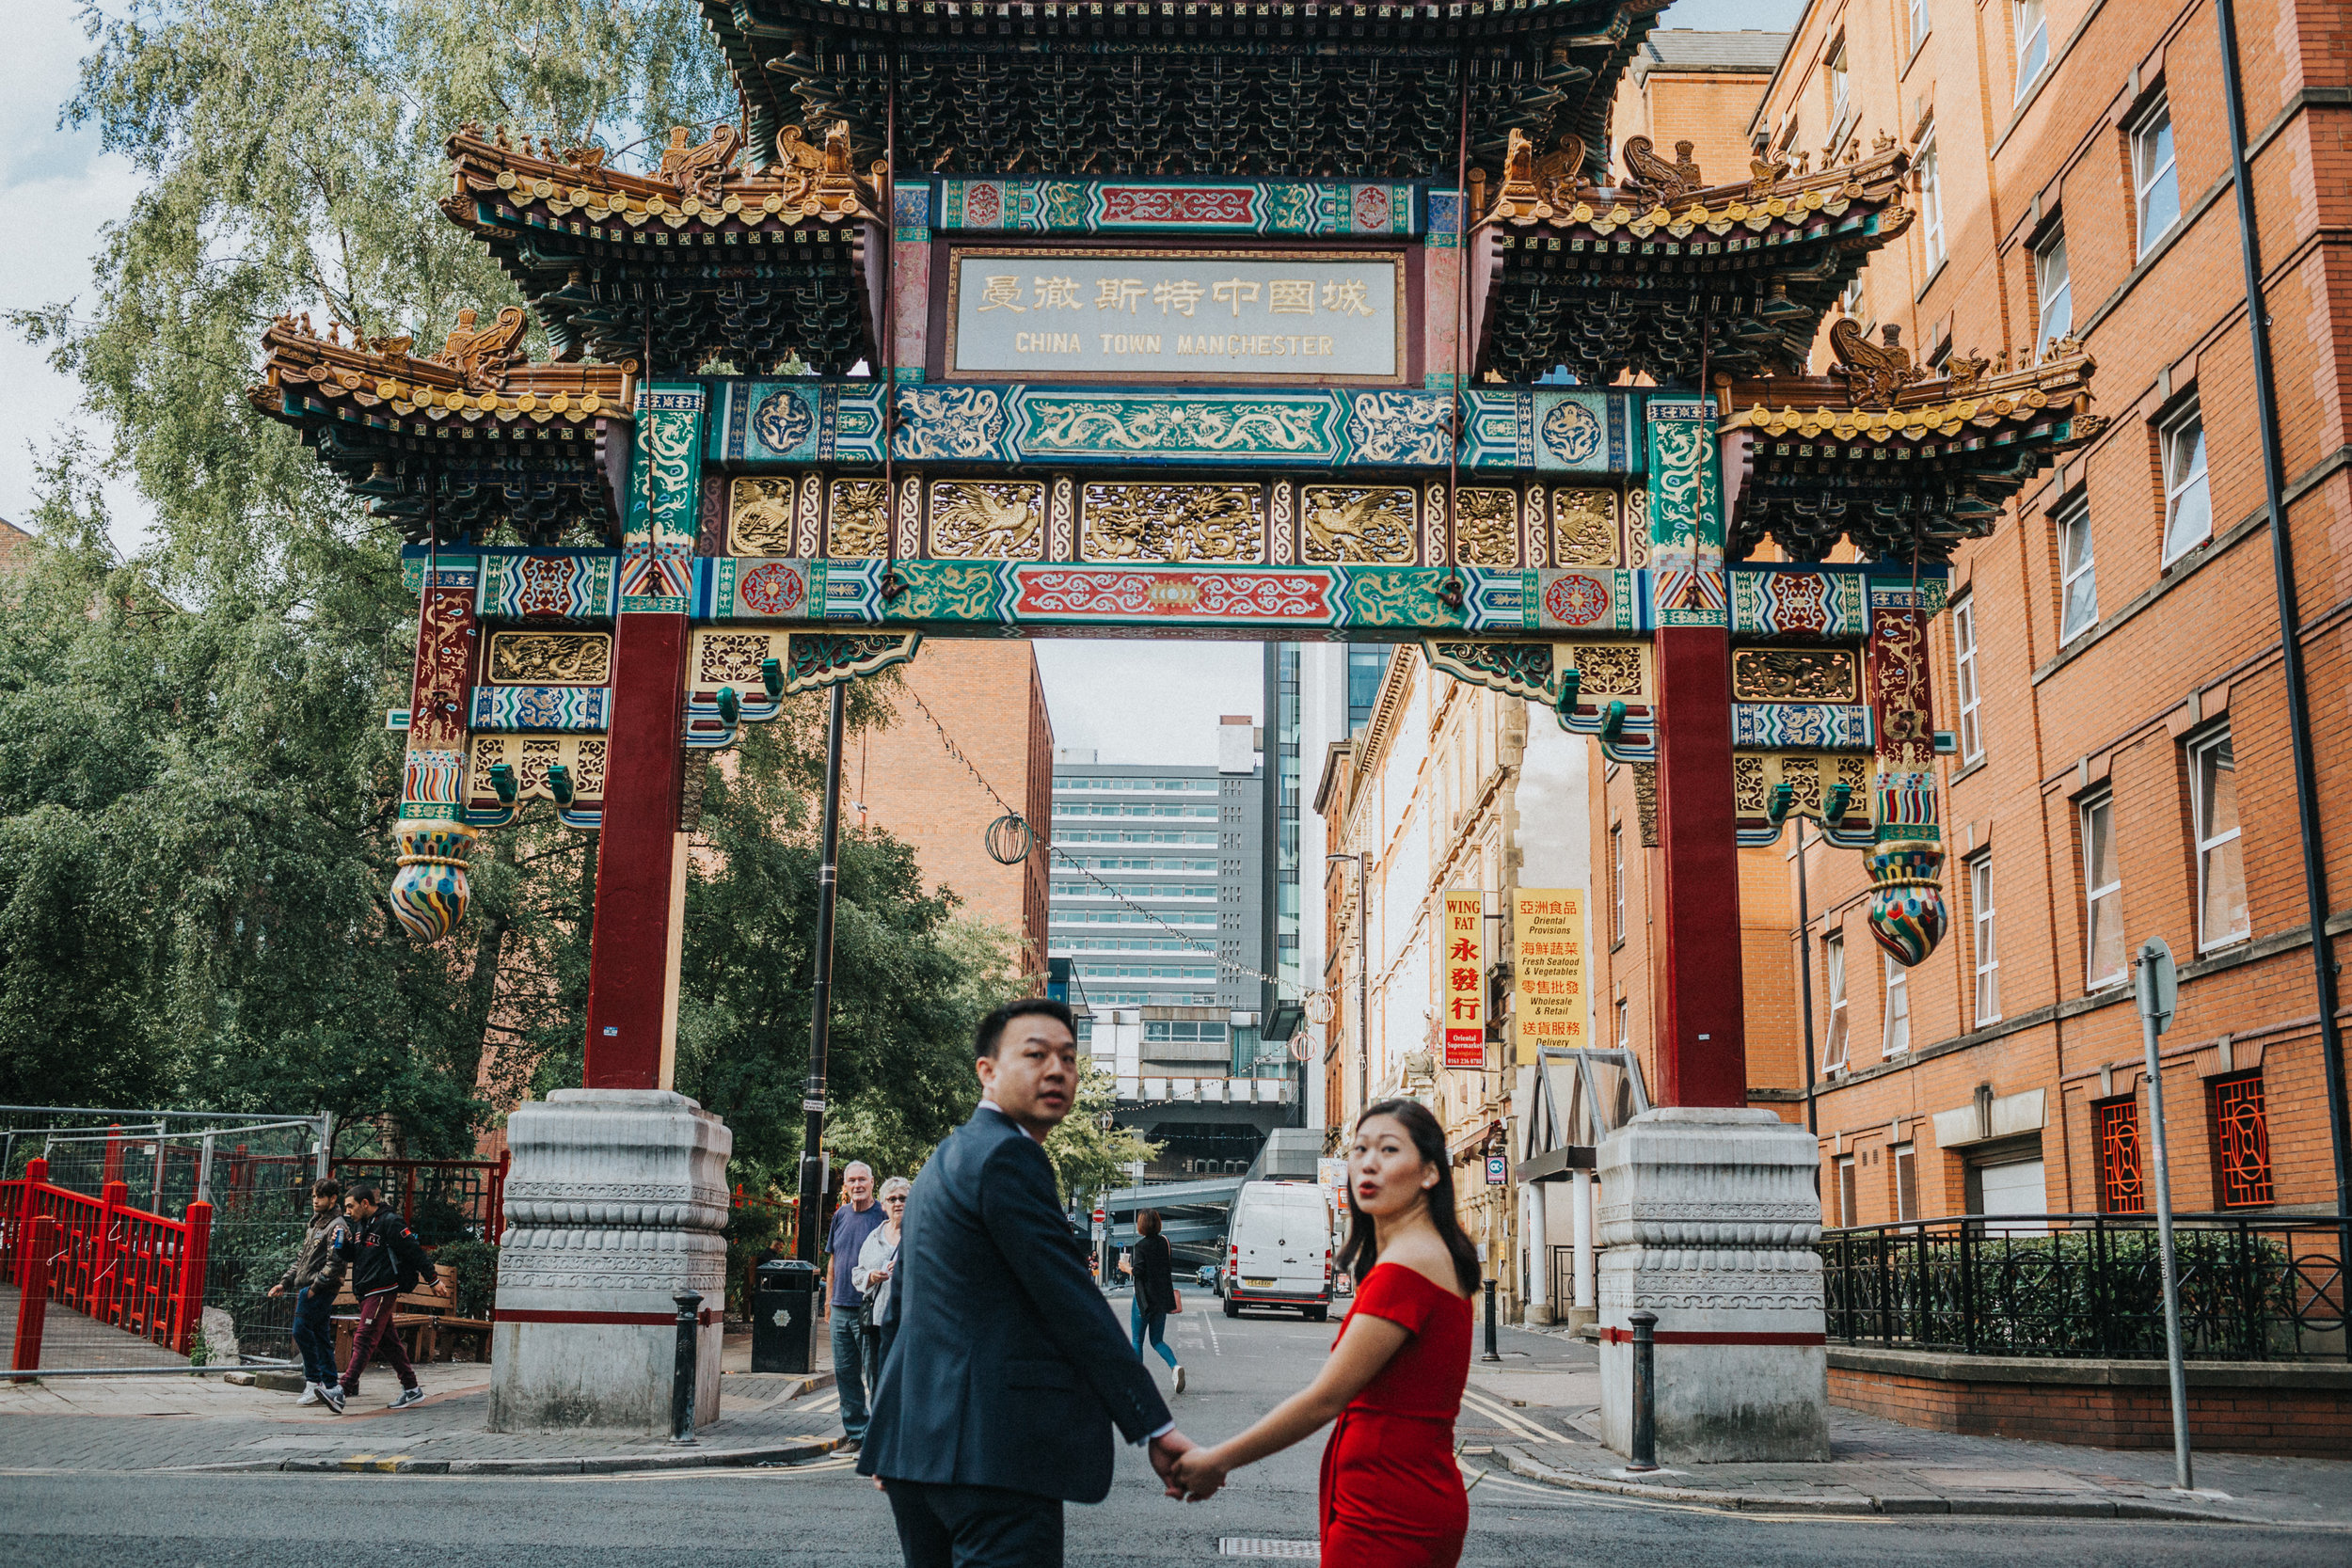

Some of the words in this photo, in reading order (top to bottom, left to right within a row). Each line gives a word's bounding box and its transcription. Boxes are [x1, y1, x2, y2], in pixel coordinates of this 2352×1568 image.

[977, 275, 1375, 318] 曼徹斯特中國城
[1015, 332, 1081, 353] CHINA
[1100, 334, 1162, 355] TOWN
[1177, 335, 1333, 356] MANCHESTER
[1446, 900, 1481, 914] WING
[1519, 900, 1577, 915] 亞洲食品
[1454, 916, 1475, 930] FAT
[1534, 916, 1566, 926] Oriental
[1529, 926, 1571, 935] Provisions
[1521, 942, 1579, 957] 海鮮蔬菜
[1521, 957, 1545, 966] Fresh
[1547, 957, 1581, 966] Seafood
[1450, 937, 1481, 1021] 永發行
[1524, 967, 1531, 975] &
[1534, 967, 1578, 977] Vegetables
[1521, 979, 1579, 994] 零售批發
[1530, 997, 1573, 1006] Wholesale
[1534, 1006, 1541, 1015] &
[1543, 1006, 1568, 1015] Retail
[1522, 1022, 1581, 1037] 送貨服務
[1447, 1041, 1483, 1050] Supermarket
[1535, 1037, 1570, 1048] Delivery
